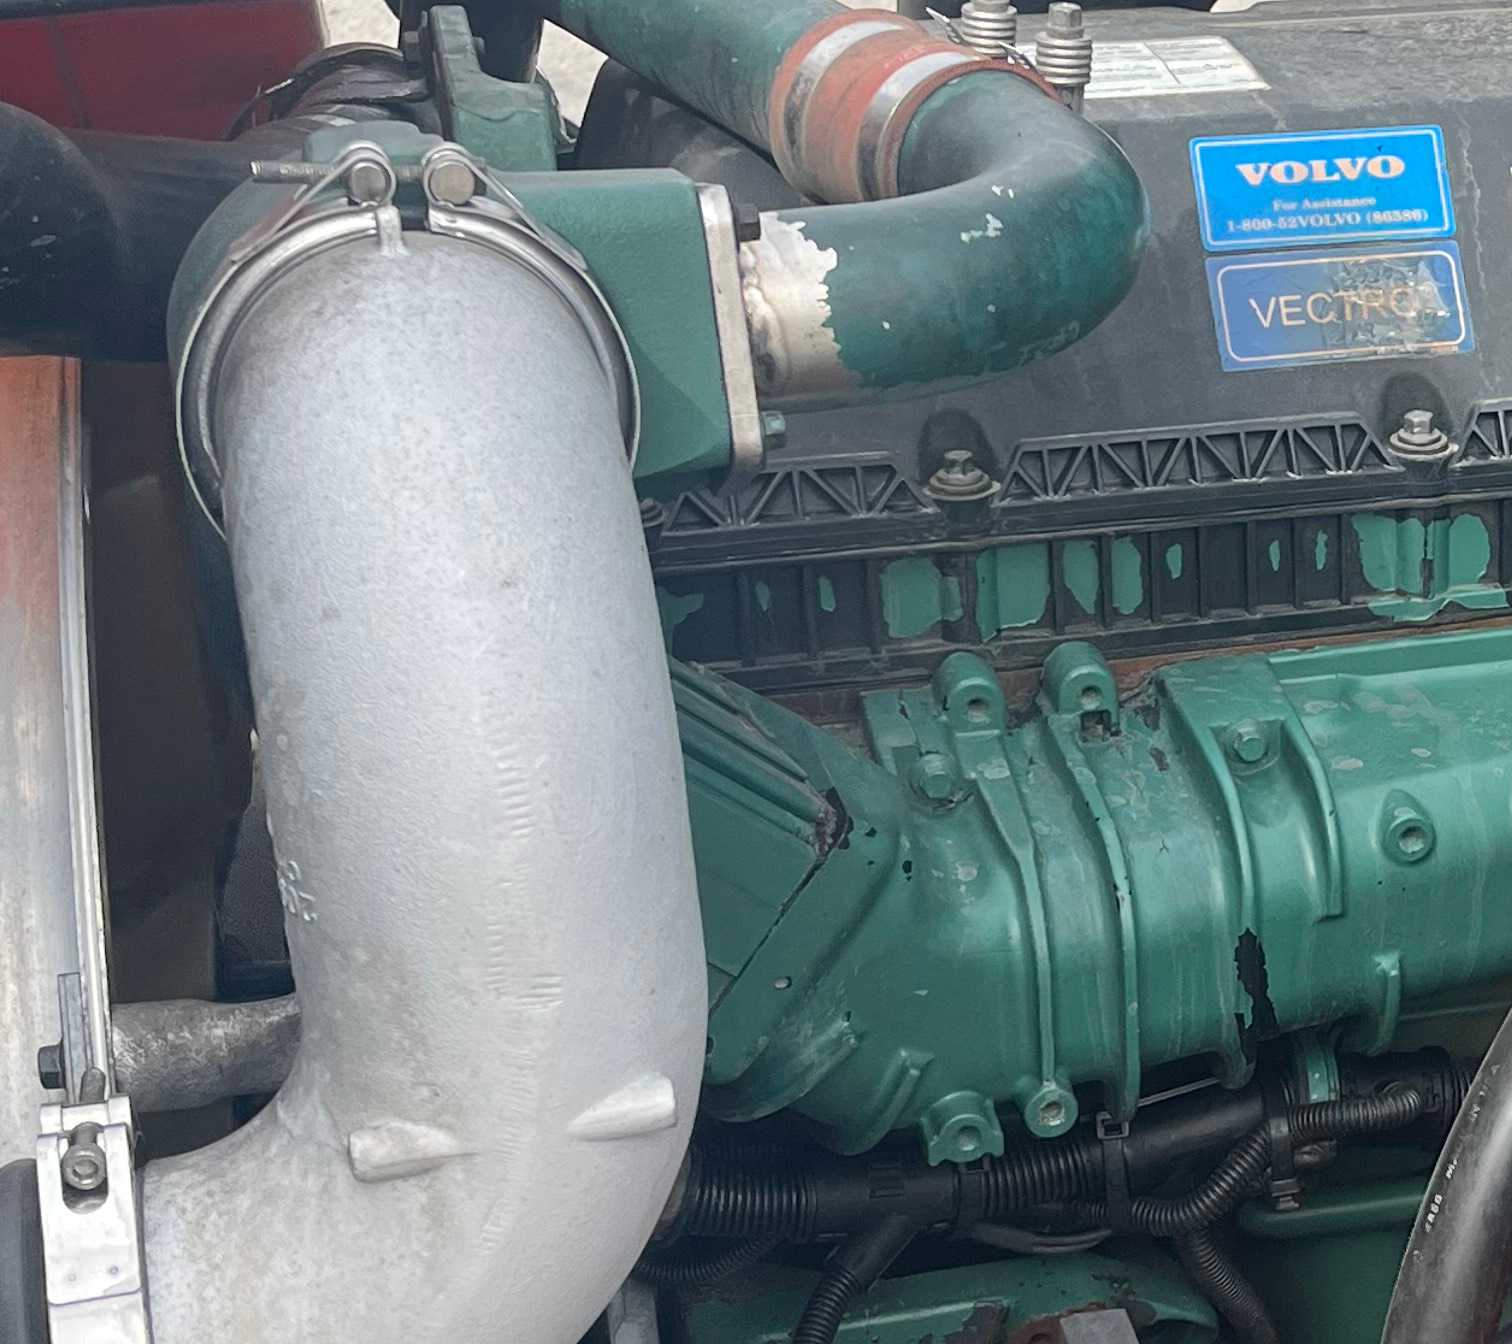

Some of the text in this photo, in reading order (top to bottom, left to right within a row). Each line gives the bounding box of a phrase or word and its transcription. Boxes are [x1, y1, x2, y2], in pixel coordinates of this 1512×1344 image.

[1235, 155, 1406, 187] VOLVO
[1273, 196, 1377, 212] For Assistance
[1226, 211, 1362, 233] 1-800-52VOLVO
